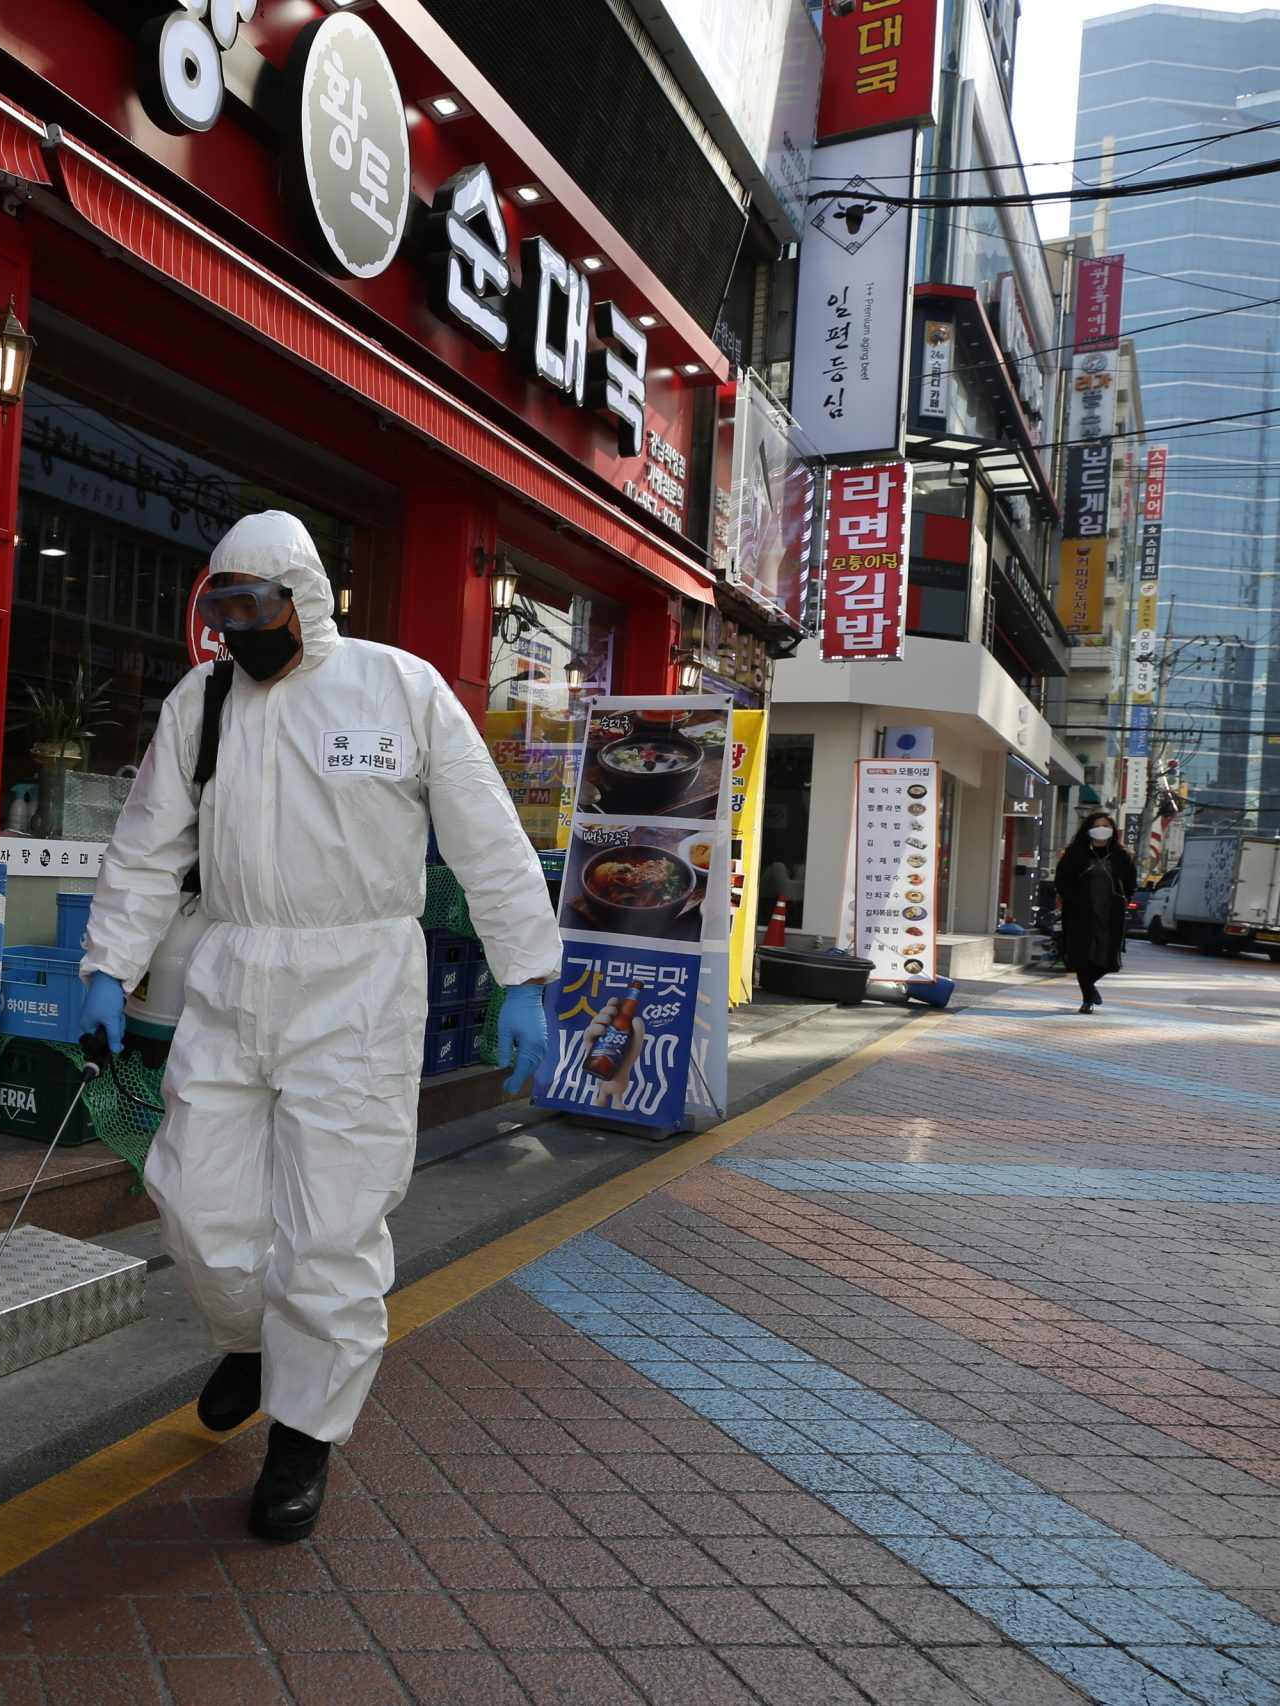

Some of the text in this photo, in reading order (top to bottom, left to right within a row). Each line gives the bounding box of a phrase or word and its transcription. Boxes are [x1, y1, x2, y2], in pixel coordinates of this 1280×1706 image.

[856, 0, 902, 94] 대국
[320, 52, 393, 235] 황토
[438, 164, 647, 457] 순대국
[863, 299, 873, 335] Premium
[823, 286, 851, 419] 일편등심
[860, 336, 870, 361] aging
[861, 362, 870, 381] beef
[930, 390, 940, 408] 카페
[1079, 447, 1108, 535] 보드게임
[1147, 452, 1164, 513] 스페인어
[839, 472, 897, 550] 라면
[1073, 556, 1089, 623] 커피랑도서관
[835, 573, 891, 650] 김밥
[1137, 631, 1150, 692] 모임간대여
[600, 716, 630, 731] 순대국
[327, 754, 396, 770] 현장 지원팀
[1013, 801, 1029, 812] kt
[583, 830, 630, 846] 뼈해장국
[1, 850, 31, 864] 자탕
[558, 957, 688, 1021] 갓 만든맛
[7, 998, 59, 1017] 하이트진로
[649, 1018, 674, 1026] FRESH
